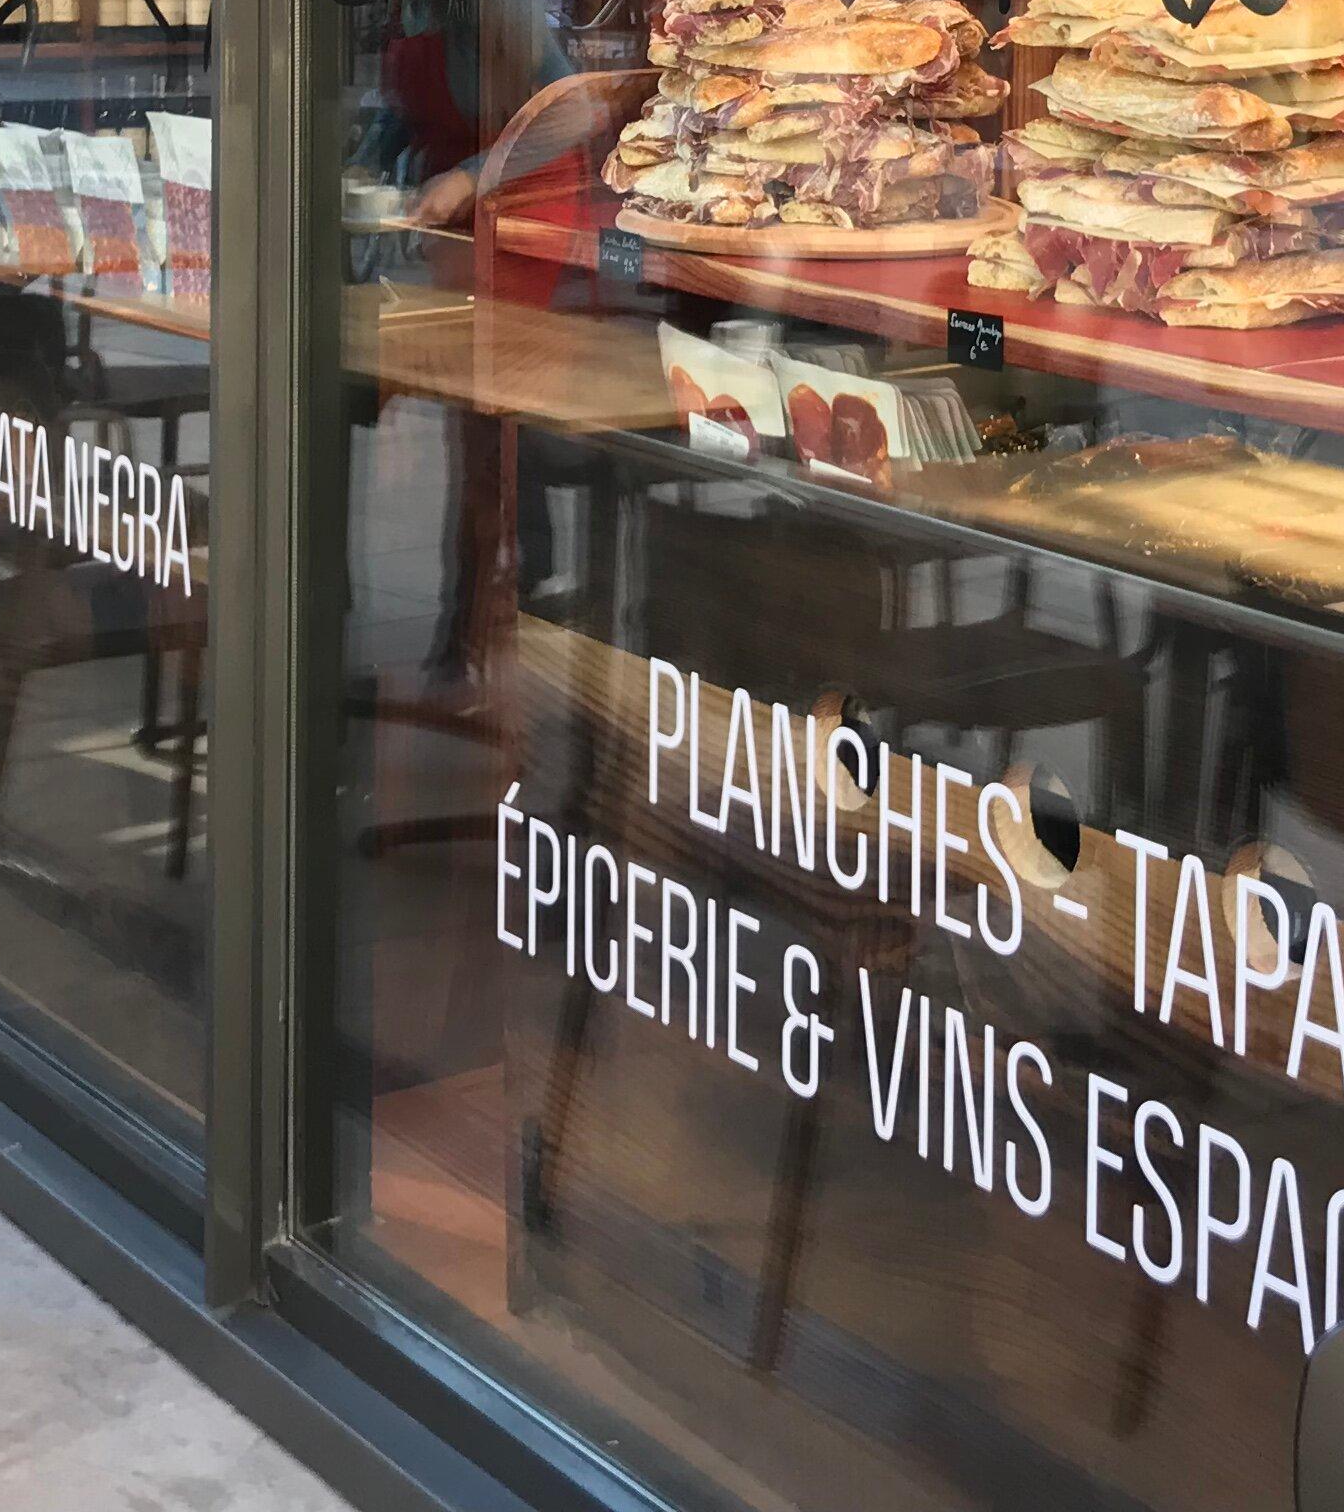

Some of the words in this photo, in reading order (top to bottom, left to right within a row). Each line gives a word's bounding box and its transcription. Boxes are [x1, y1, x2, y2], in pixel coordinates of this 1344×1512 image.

[63, 434, 192, 598] NEGRA
[649, 656, 1024, 956] PLANCHES
[496, 781, 760, 1072] ÉPICERIE
[781, 943, 835, 1098] &
[858, 966, 1054, 1217] VINS
